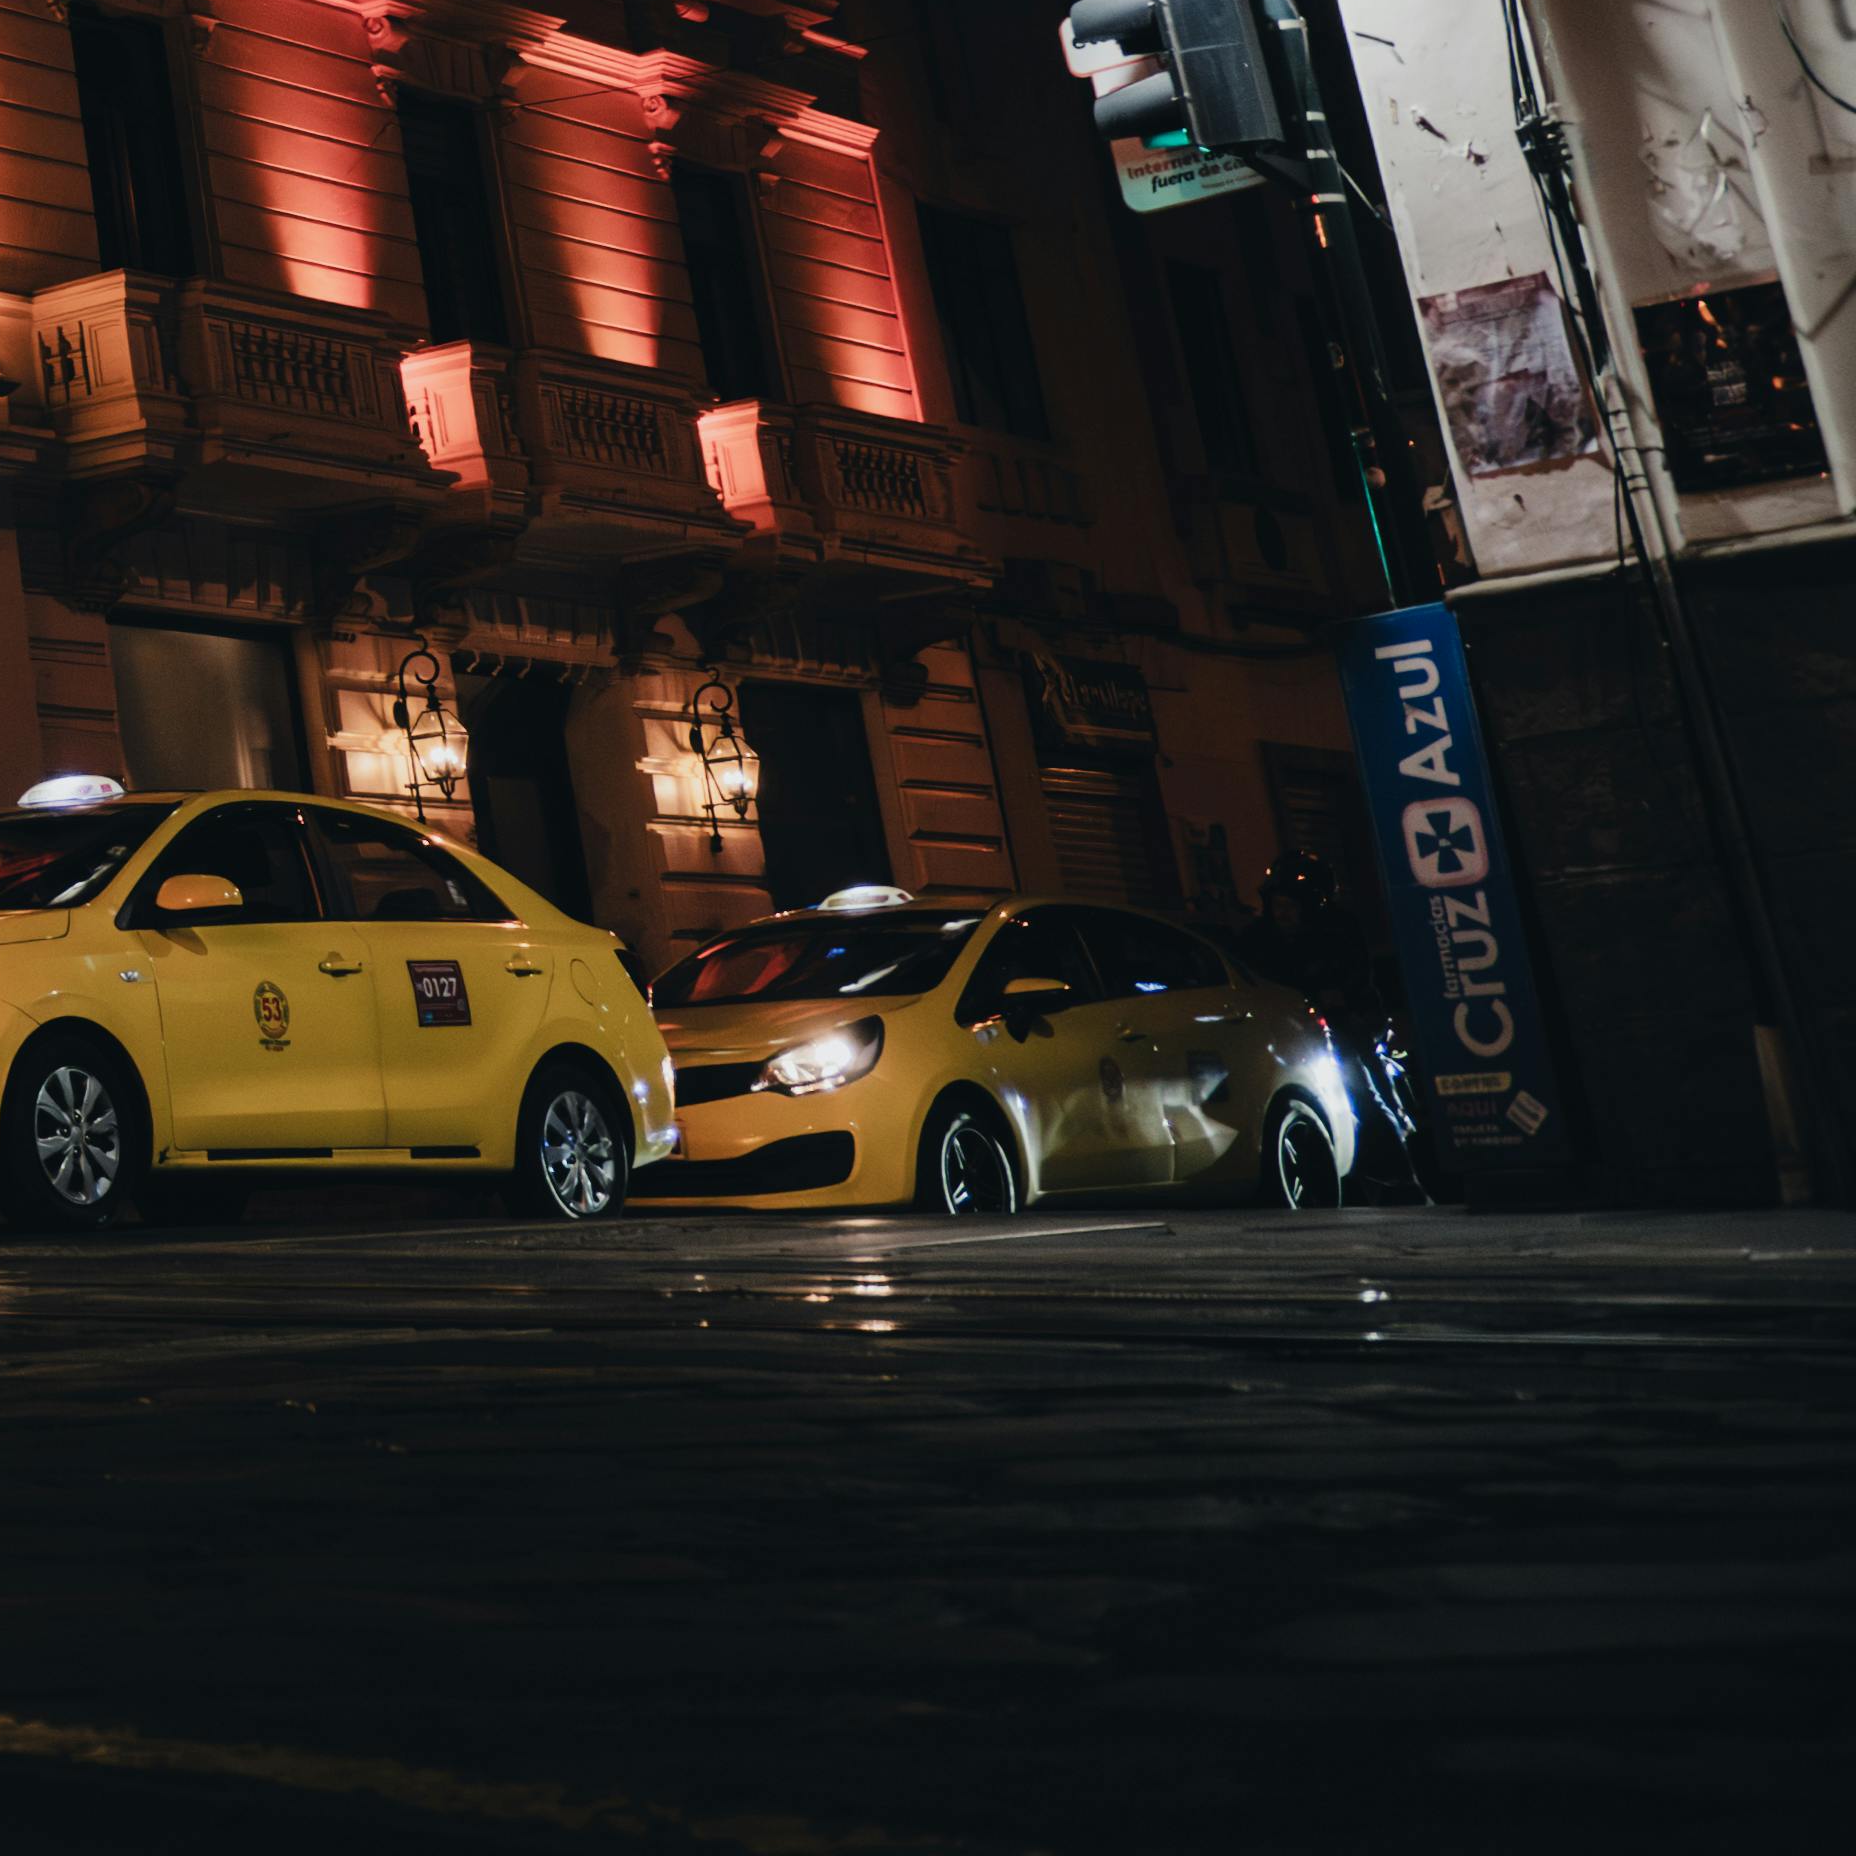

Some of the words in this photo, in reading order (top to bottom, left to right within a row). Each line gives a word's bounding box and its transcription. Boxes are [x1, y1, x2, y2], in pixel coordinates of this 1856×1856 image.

[1127, 152, 1200, 179] Internet
[1151, 169, 1195, 192] fuera
[1198, 159, 1221, 177] de
[1375, 638, 1462, 787] Azul
[1429, 895, 1461, 999] farmacias
[422, 976, 457, 999] 0127
[1443, 890, 1515, 1058] Cruz
[261, 997, 282, 1022] 53
